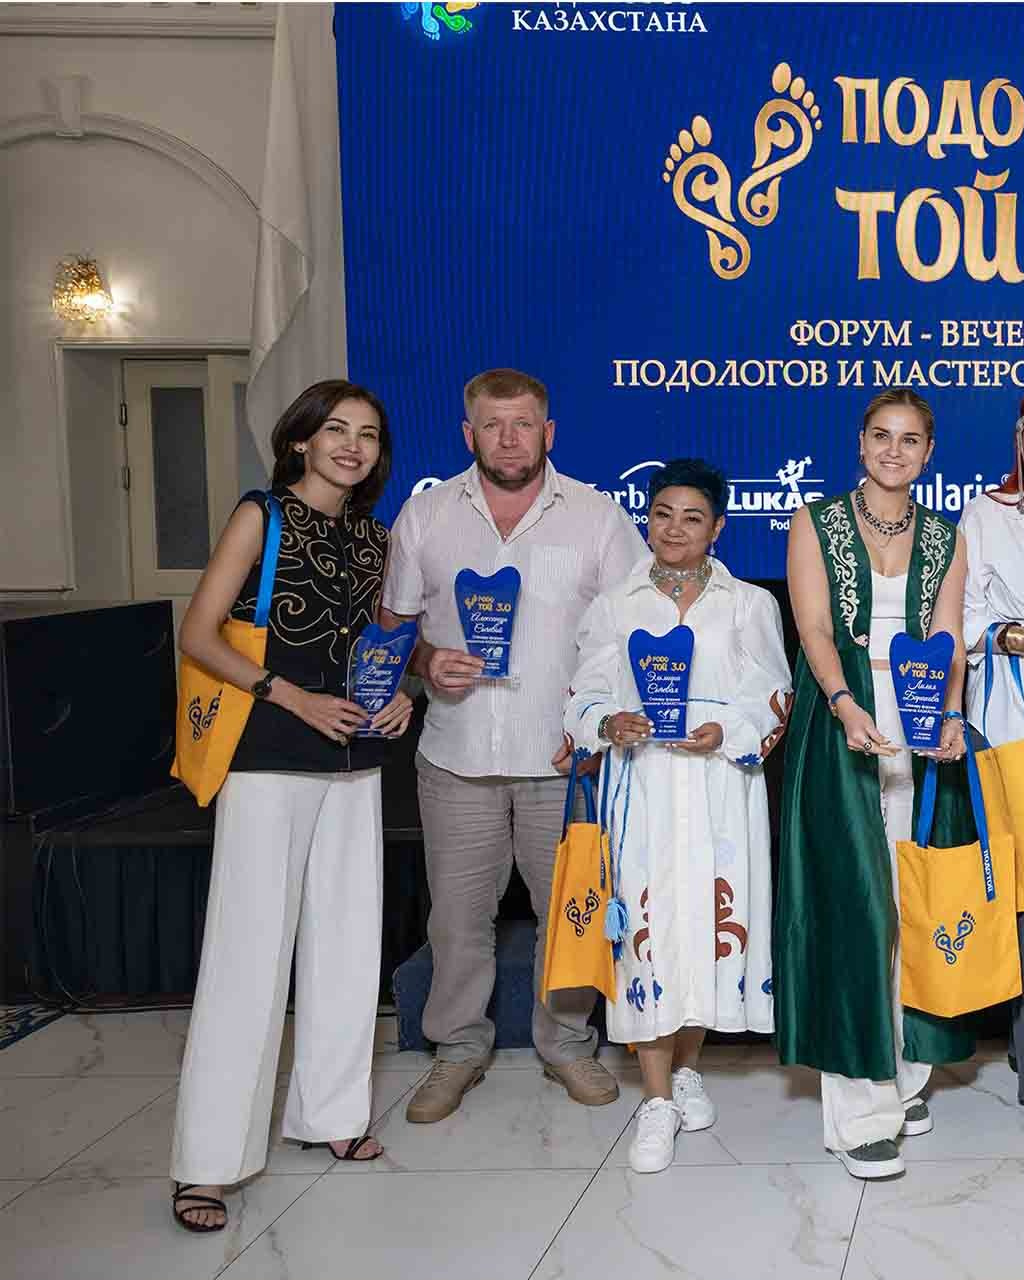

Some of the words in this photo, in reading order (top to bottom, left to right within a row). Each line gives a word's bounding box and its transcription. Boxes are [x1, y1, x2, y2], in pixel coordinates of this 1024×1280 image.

[512, 10, 707, 32] КАЗАХСТАНА
[834, 76, 1024, 159] ПОДО
[790, 320, 912, 346] ФОРУМ
[613, 360, 828, 392] ПОДОЛОГОВ
[838, 361, 864, 386] И
[928, 670, 944, 680] 3.0
